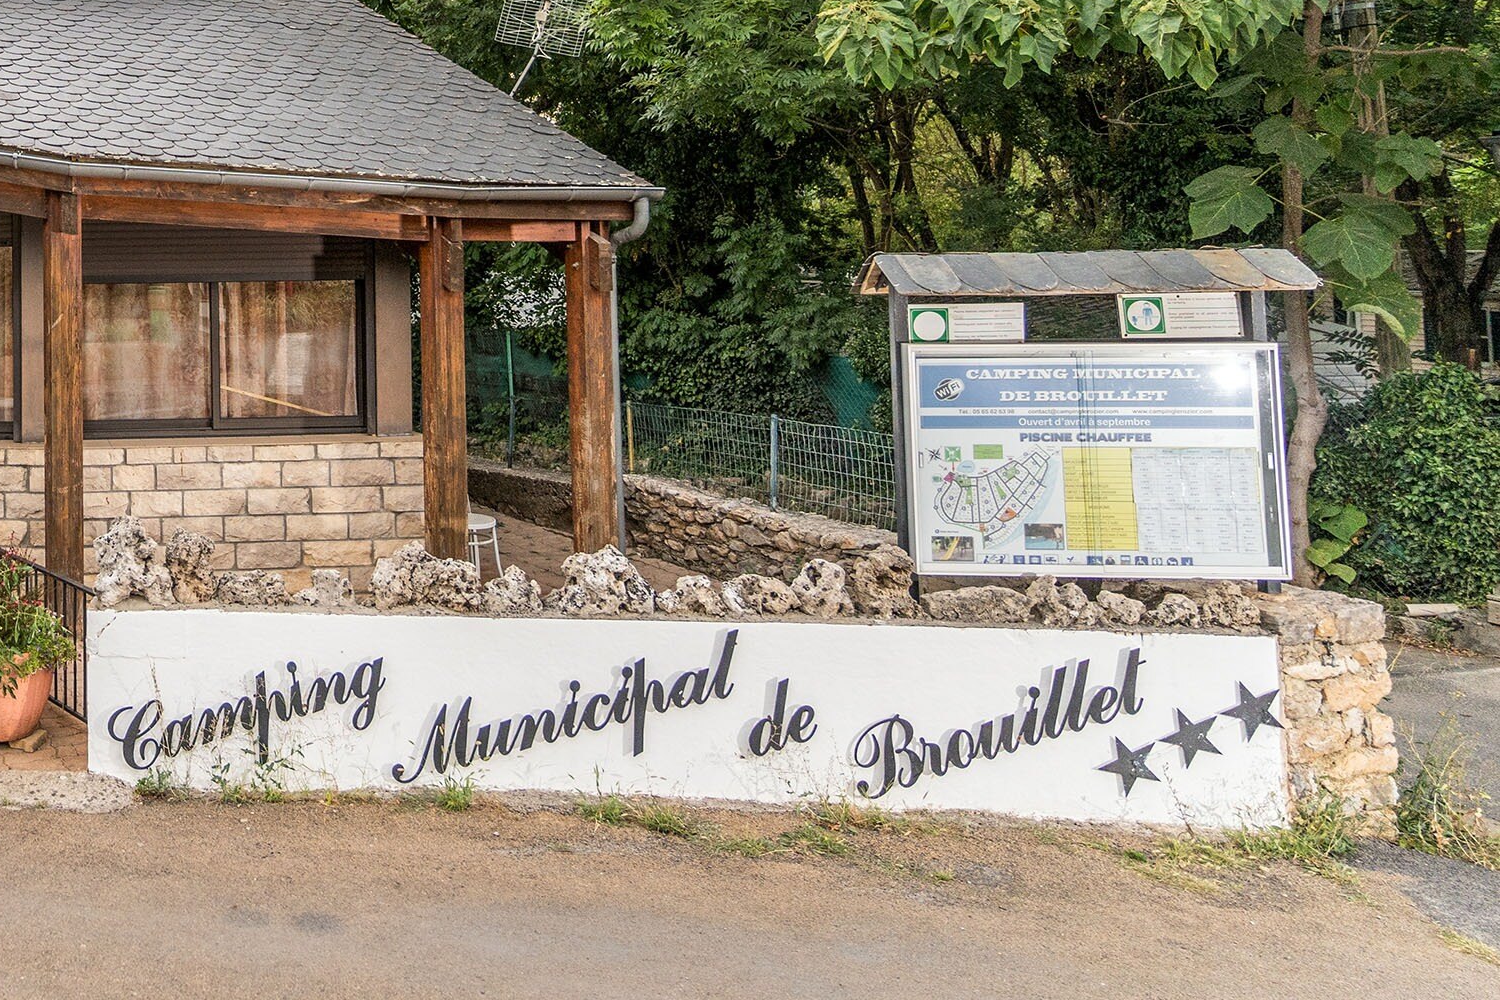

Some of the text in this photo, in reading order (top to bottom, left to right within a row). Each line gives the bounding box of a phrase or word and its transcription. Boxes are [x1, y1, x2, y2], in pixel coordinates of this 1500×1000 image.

[965, 367, 1200, 380] CAMPING MUNICIPAL
[999, 390, 1168, 402] DE BROUILLET
[1018, 417, 1053, 426] Ouvert
[1088, 417, 1095, 426] à
[1096, 417, 1151, 427] septembre
[1019, 432, 1073, 442] PISCINE
[107, 628, 1148, 799] Camping Municipal de Brouillet
